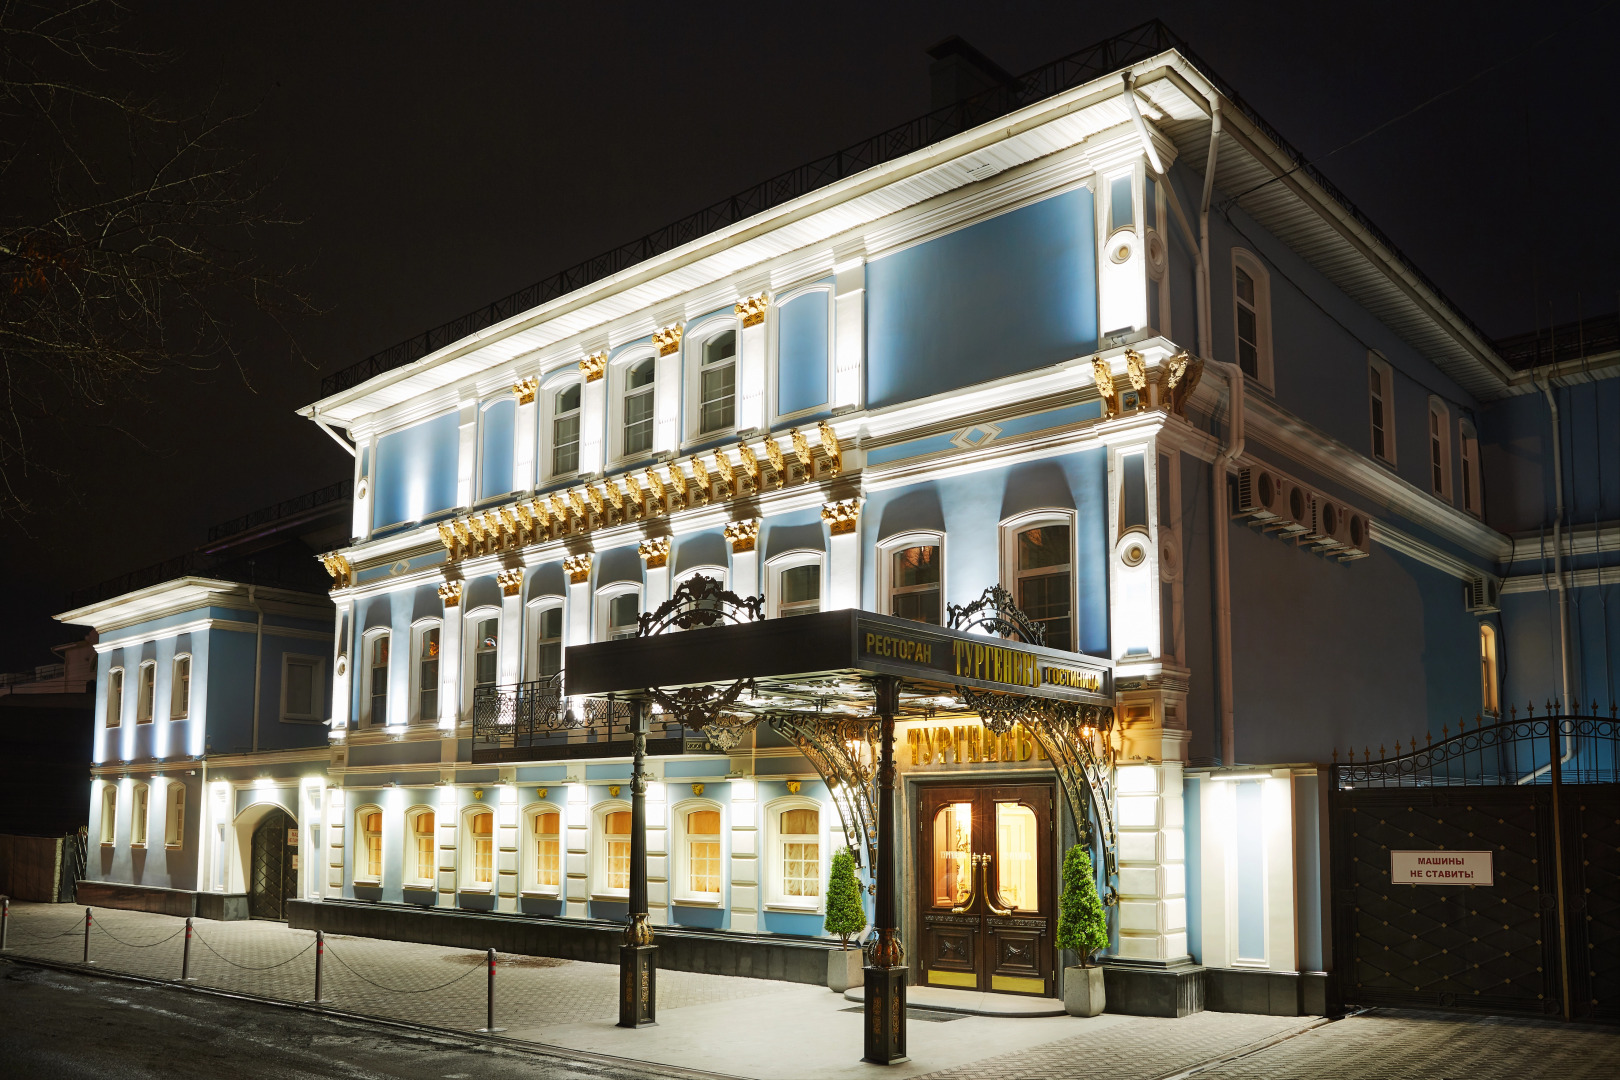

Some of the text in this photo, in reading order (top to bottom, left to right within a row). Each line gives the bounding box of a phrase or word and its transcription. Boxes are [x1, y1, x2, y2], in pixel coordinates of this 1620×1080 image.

[866, 632, 1100, 692] РЕСТОРАН ТУРГЕНЕВЪ ГОСТИНИЦА
[1417, 857, 1465, 866] МАШИНЫ
[1410, 870, 1474, 879] НЕ СТАВИТЬ!
